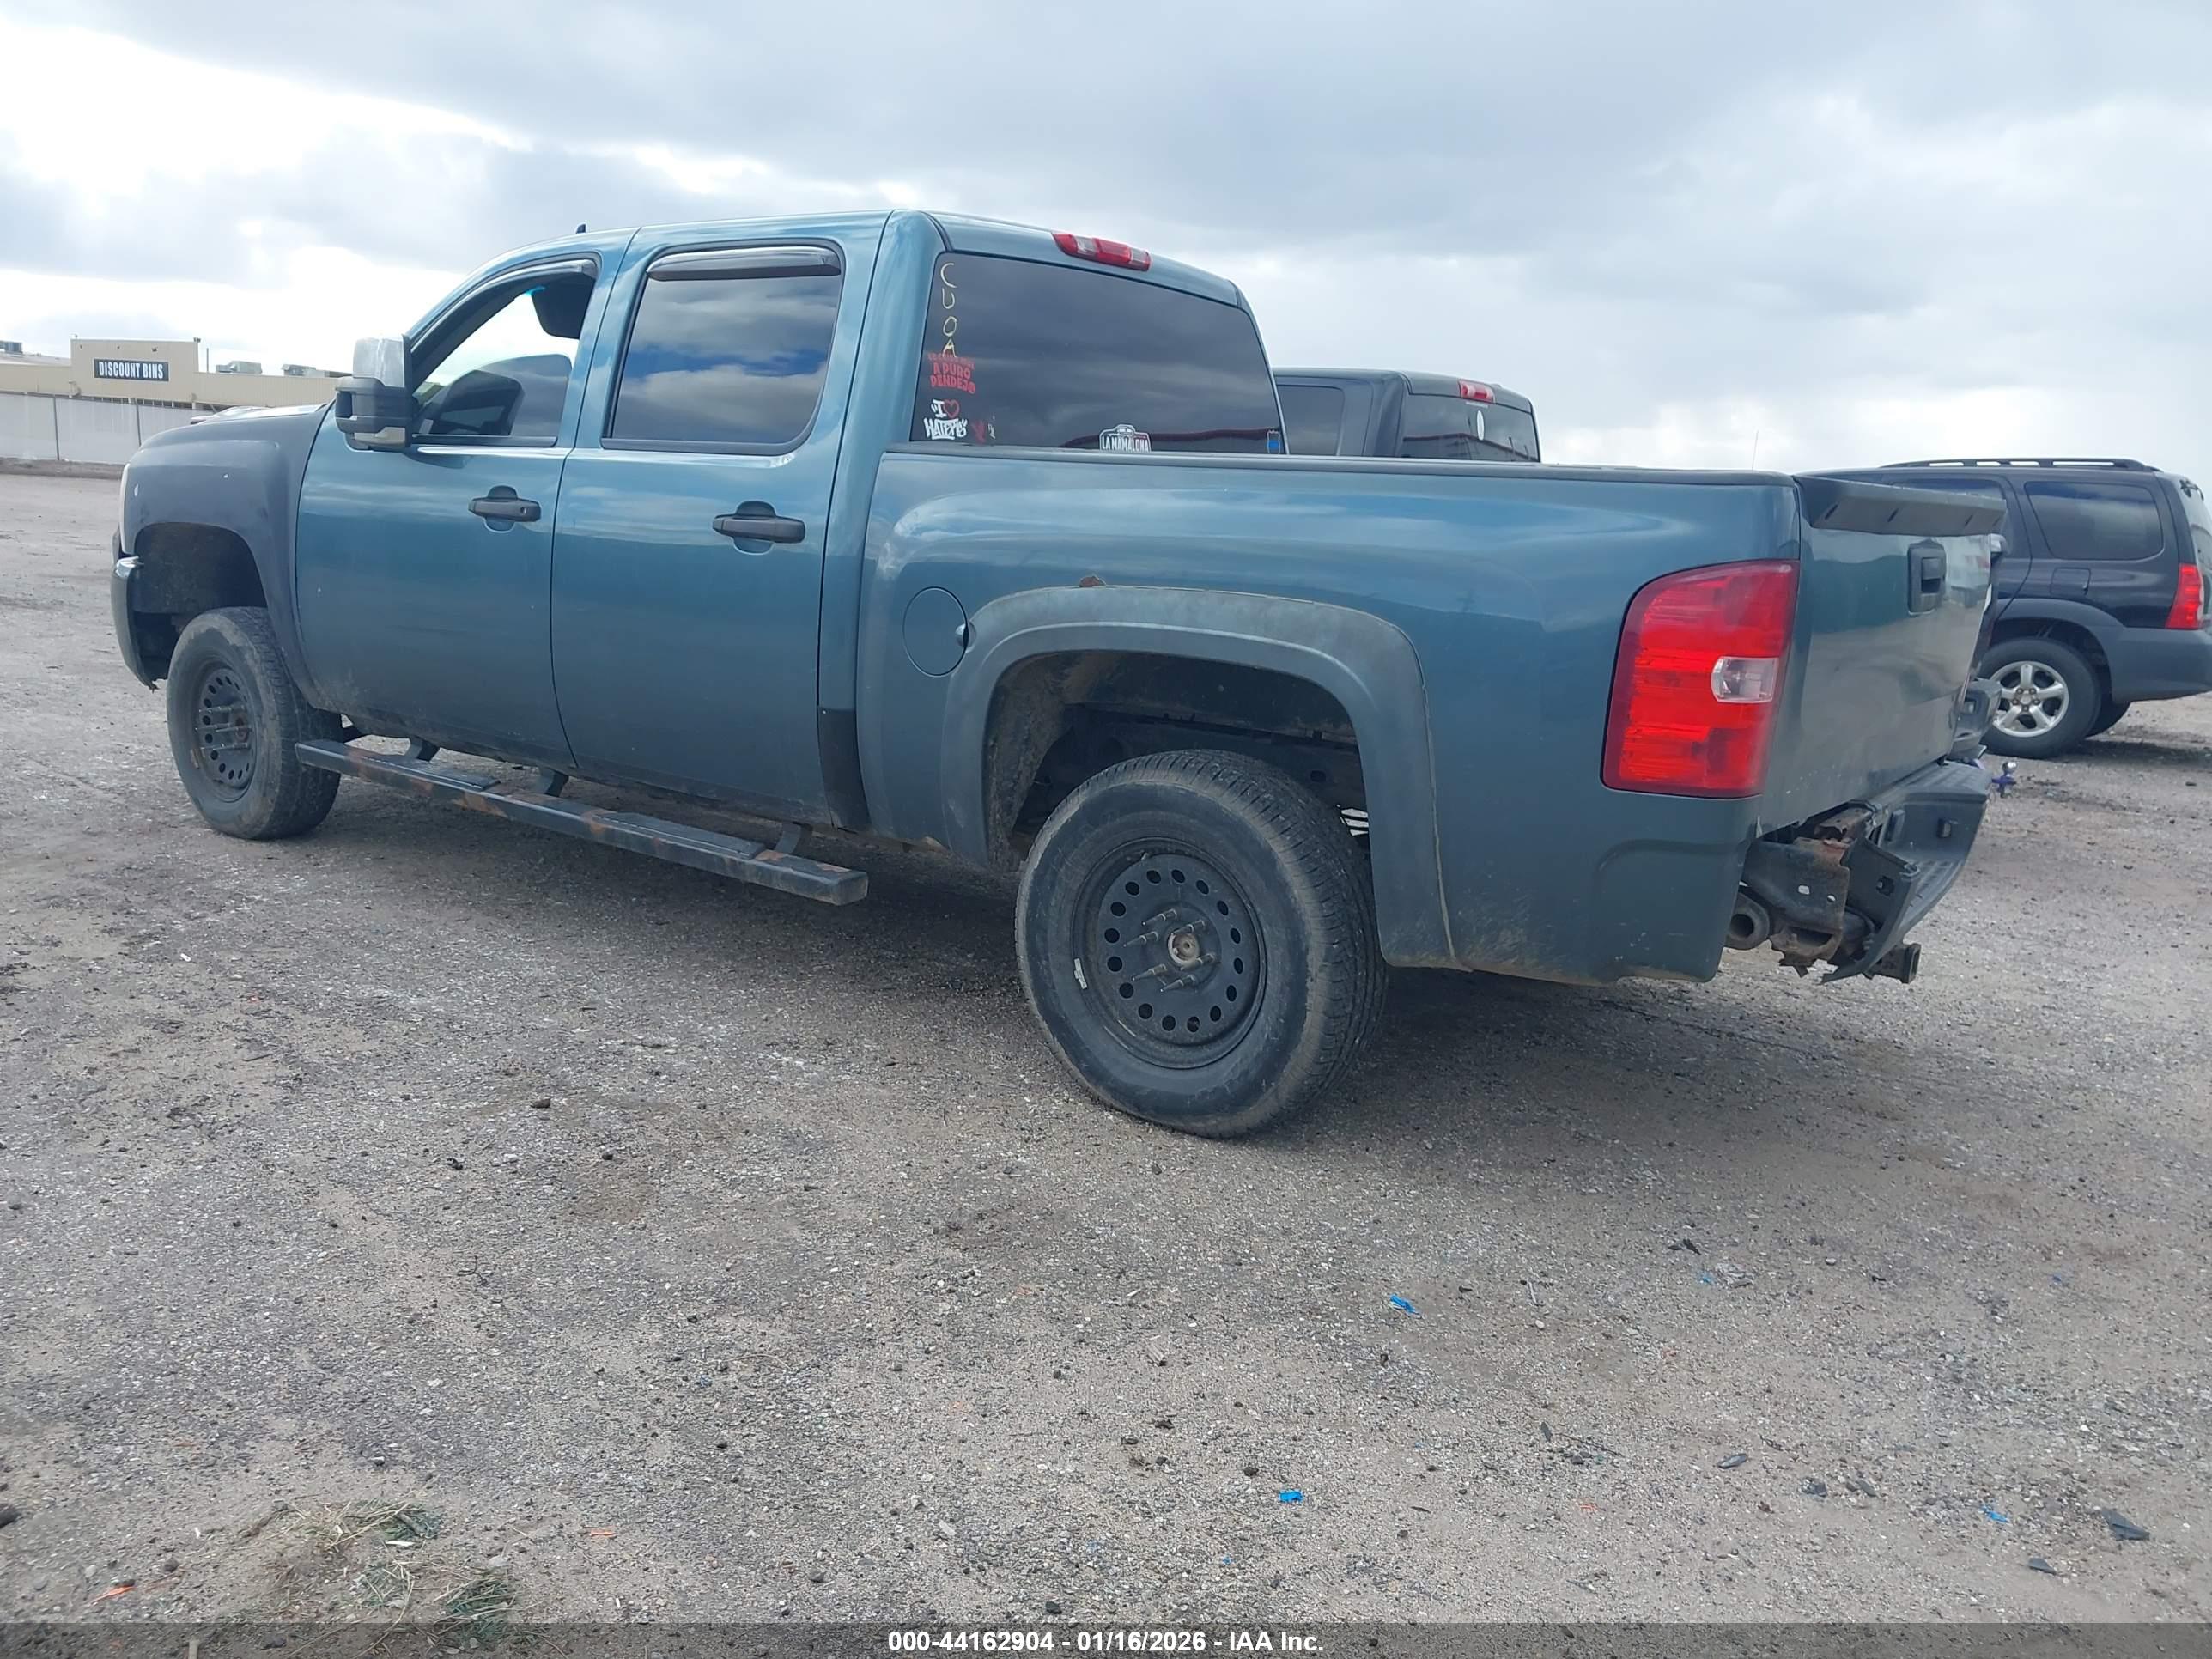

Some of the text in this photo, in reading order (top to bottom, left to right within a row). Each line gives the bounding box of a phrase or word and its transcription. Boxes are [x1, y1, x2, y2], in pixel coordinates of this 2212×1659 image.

[99, 361, 163, 379] DISCOUNT BINS
[943, 362, 971, 380] PURO
[1102, 435, 1110, 450] LA
